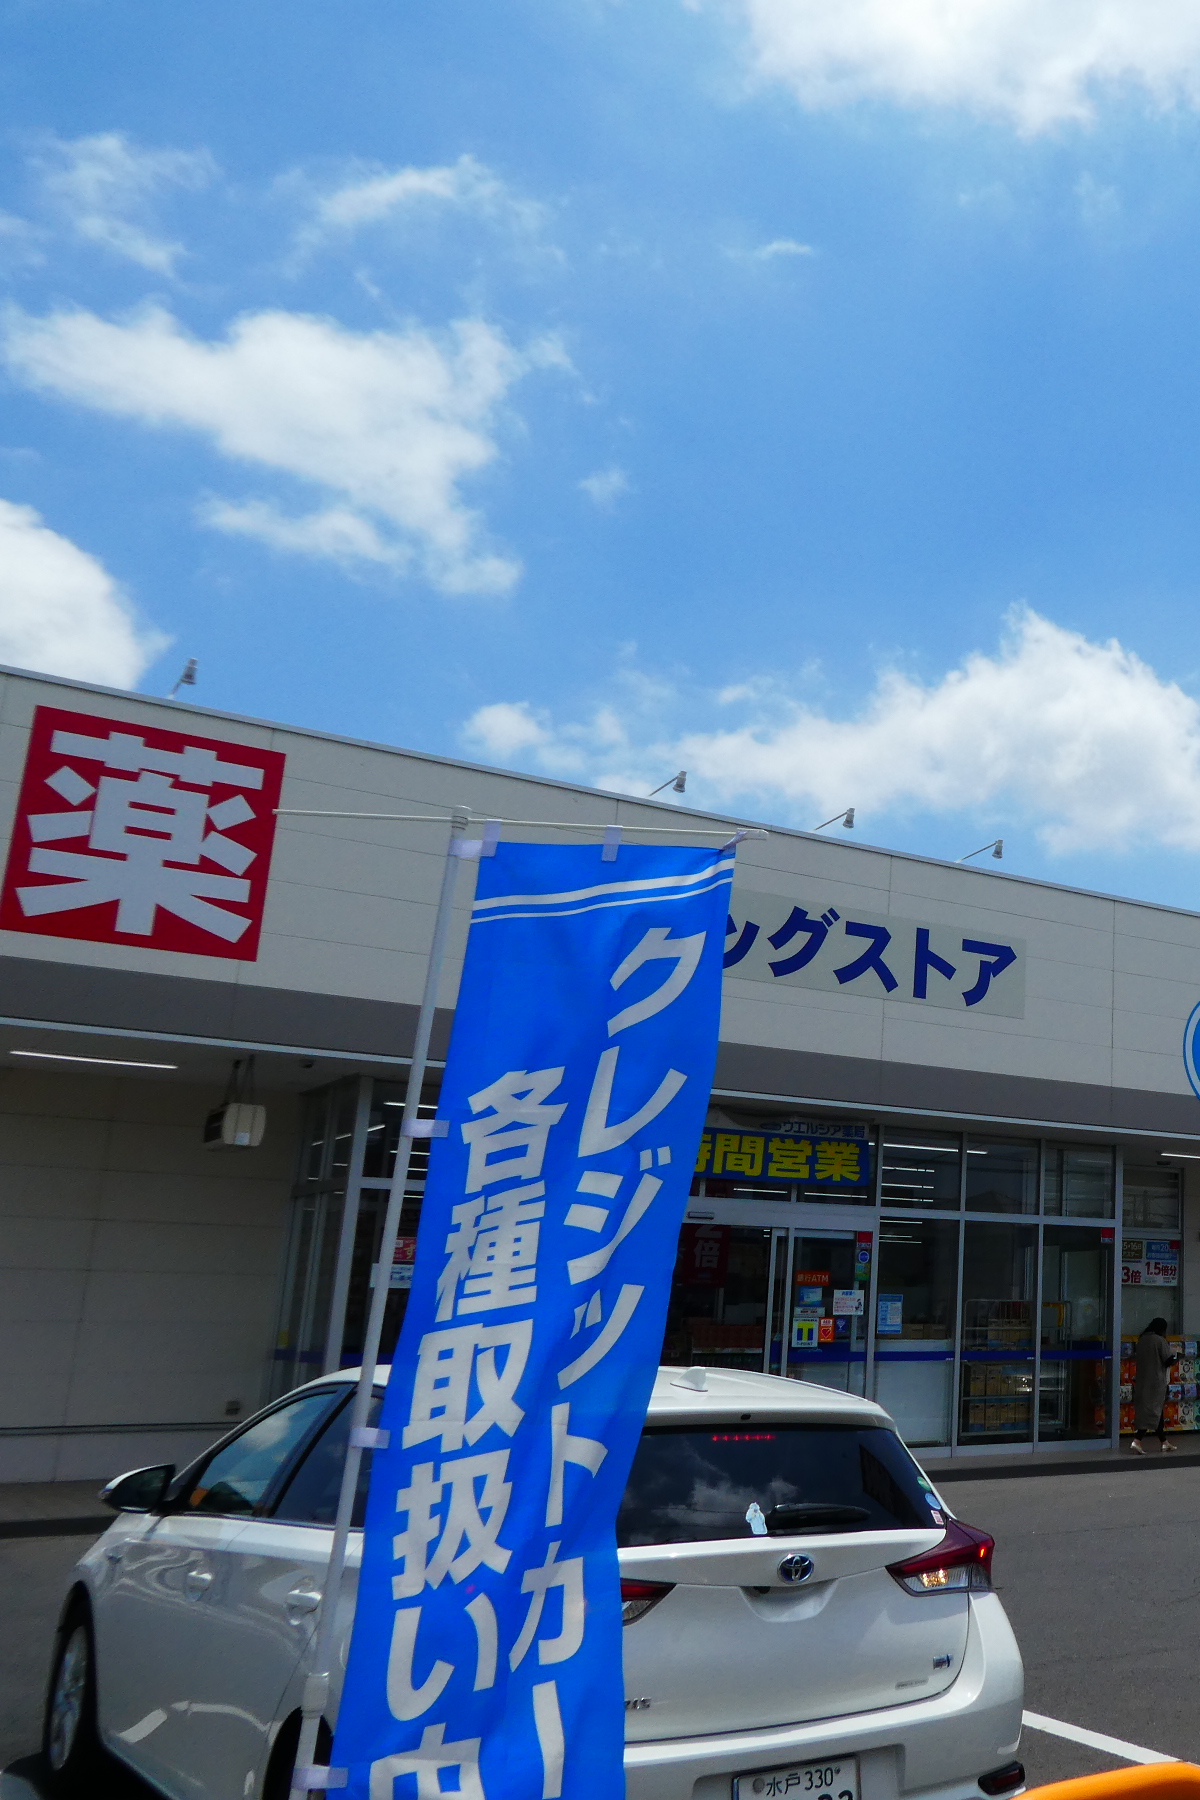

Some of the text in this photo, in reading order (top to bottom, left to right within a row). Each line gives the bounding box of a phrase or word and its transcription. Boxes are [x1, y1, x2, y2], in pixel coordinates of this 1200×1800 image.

[15, 730, 265, 944] 薬
[782, 1121, 866, 1139] ウエルシア薬局
